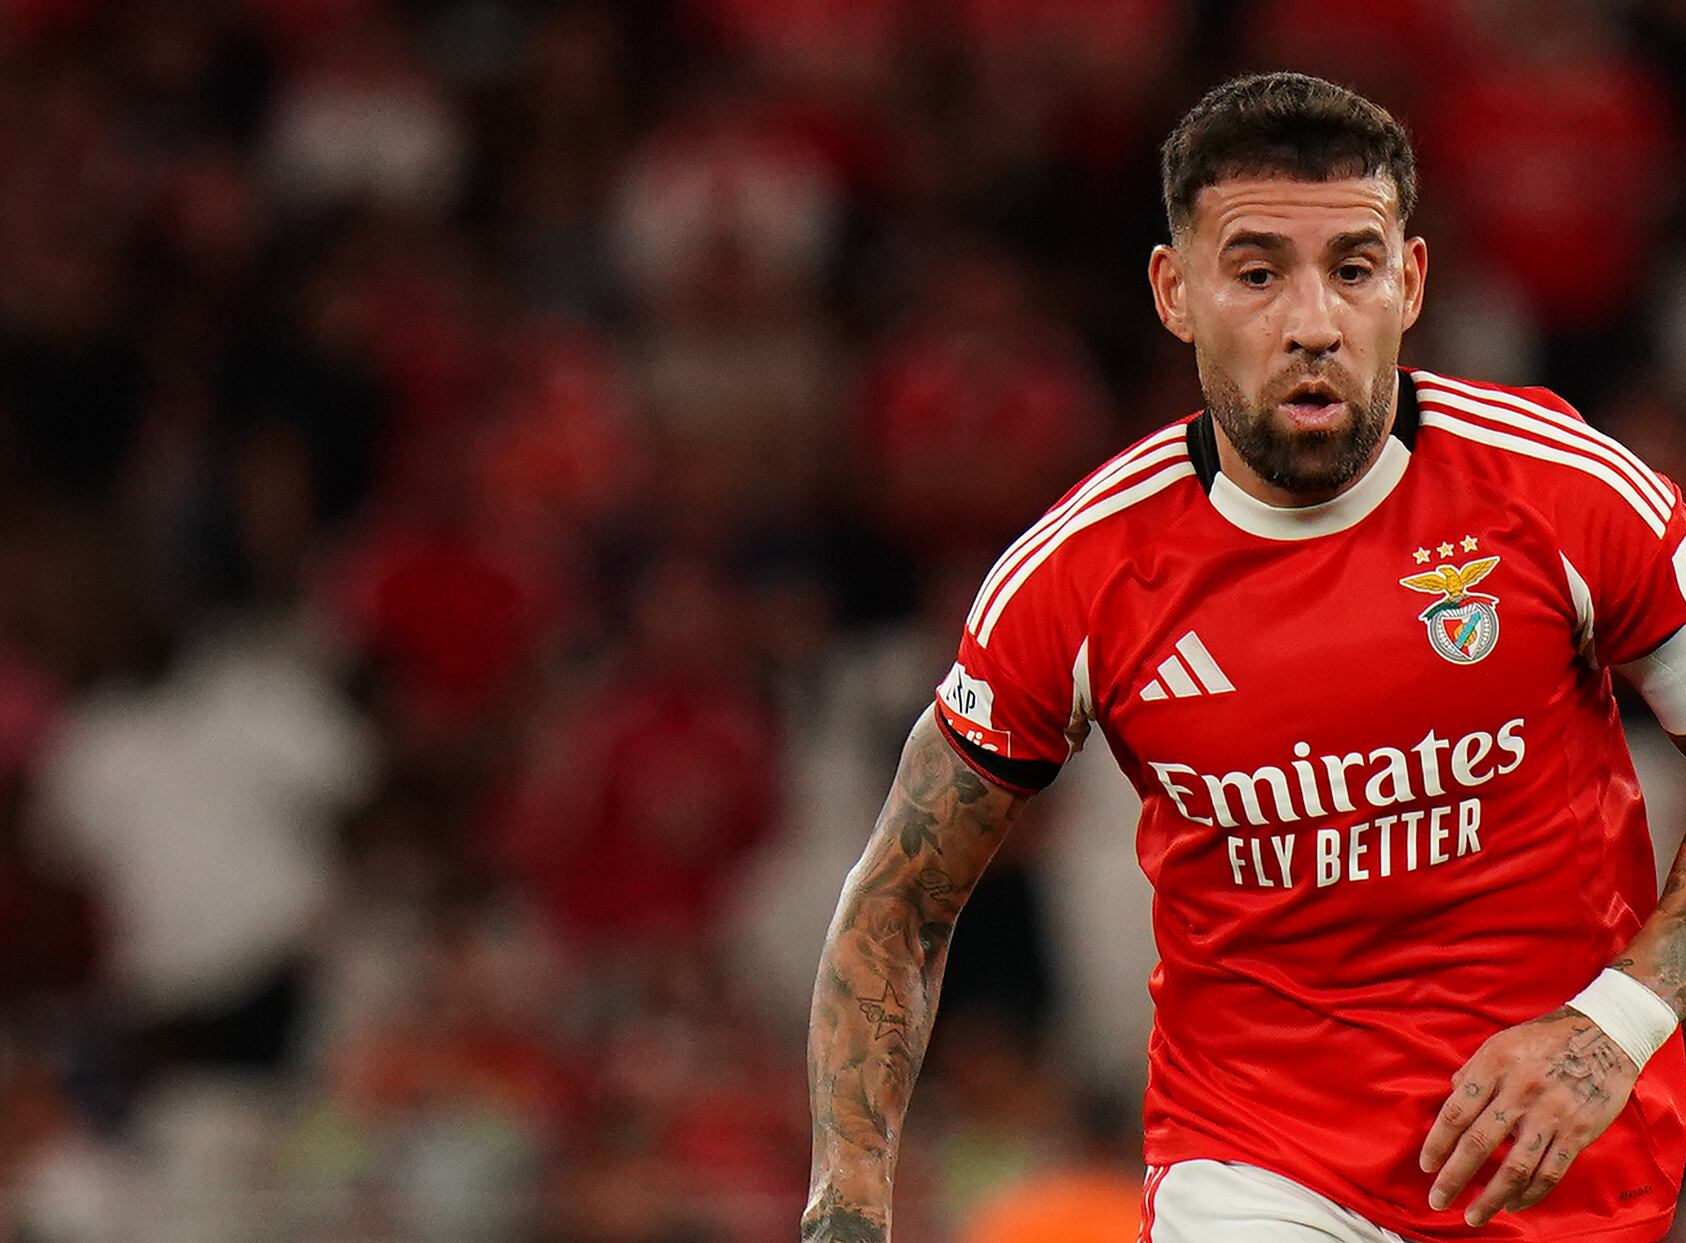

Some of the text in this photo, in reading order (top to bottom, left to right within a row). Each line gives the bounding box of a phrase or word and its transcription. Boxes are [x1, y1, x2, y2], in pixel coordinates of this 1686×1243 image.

[1147, 717, 1526, 828] Emirates
[1227, 797, 1482, 889] FLY BETTER
